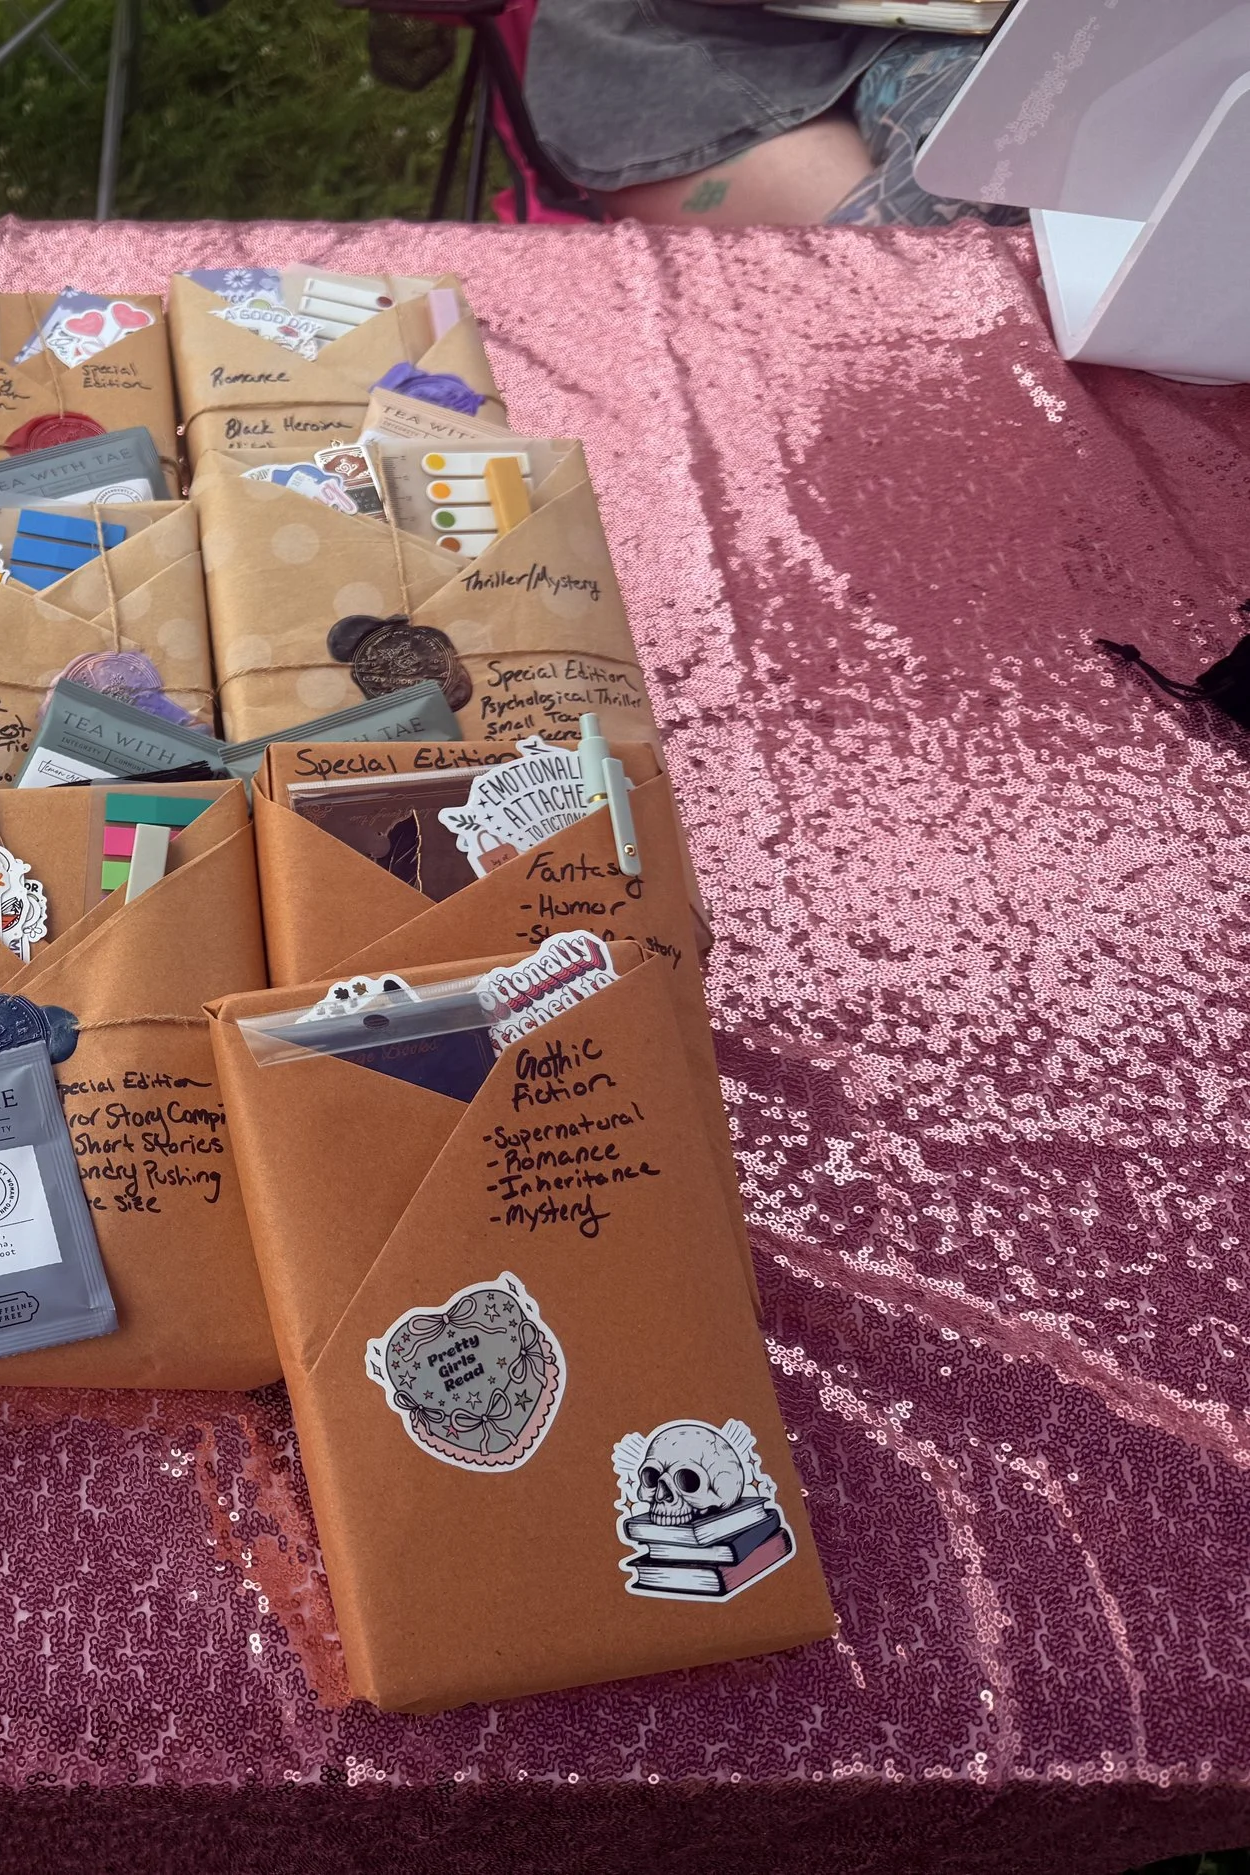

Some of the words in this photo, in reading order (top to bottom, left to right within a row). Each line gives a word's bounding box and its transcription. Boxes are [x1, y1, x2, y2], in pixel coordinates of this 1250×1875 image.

[81, 362, 138, 376] Special
[83, 376, 152, 390] Edition
[210, 367, 292, 388] Romance
[225, 418, 276, 439] Black
[381, 405, 420, 424] TEA
[30, 460, 86, 481] WITH
[92, 448, 133, 465] TAE
[461, 562, 603, 601] Thriller/Mystery
[487, 661, 557, 692] Special
[565, 660, 638, 692] Edition
[481, 691, 592, 720] Psychological
[593, 689, 642, 708] Thriller
[63, 710, 103, 738] TEA
[115, 732, 176, 765] WITH
[295, 749, 396, 780] Special
[414, 748, 517, 769] Edition
[503, 784, 587, 829] ATTACHE
[525, 825, 543, 841] TO
[516, 1038, 602, 1081] Gothic
[123, 1071, 212, 1089] Edition
[512, 1073, 616, 1112] Fiction
[105, 1103, 171, 1146] Story
[74, 1133, 134, 1155] Short
[141, 1132, 224, 1157] Stories
[143, 1160, 222, 1203] Pushing
[427, 1333, 480, 1369] Pretty
[437, 1351, 476, 1379] Girls
[443, 1362, 485, 1393] Read
